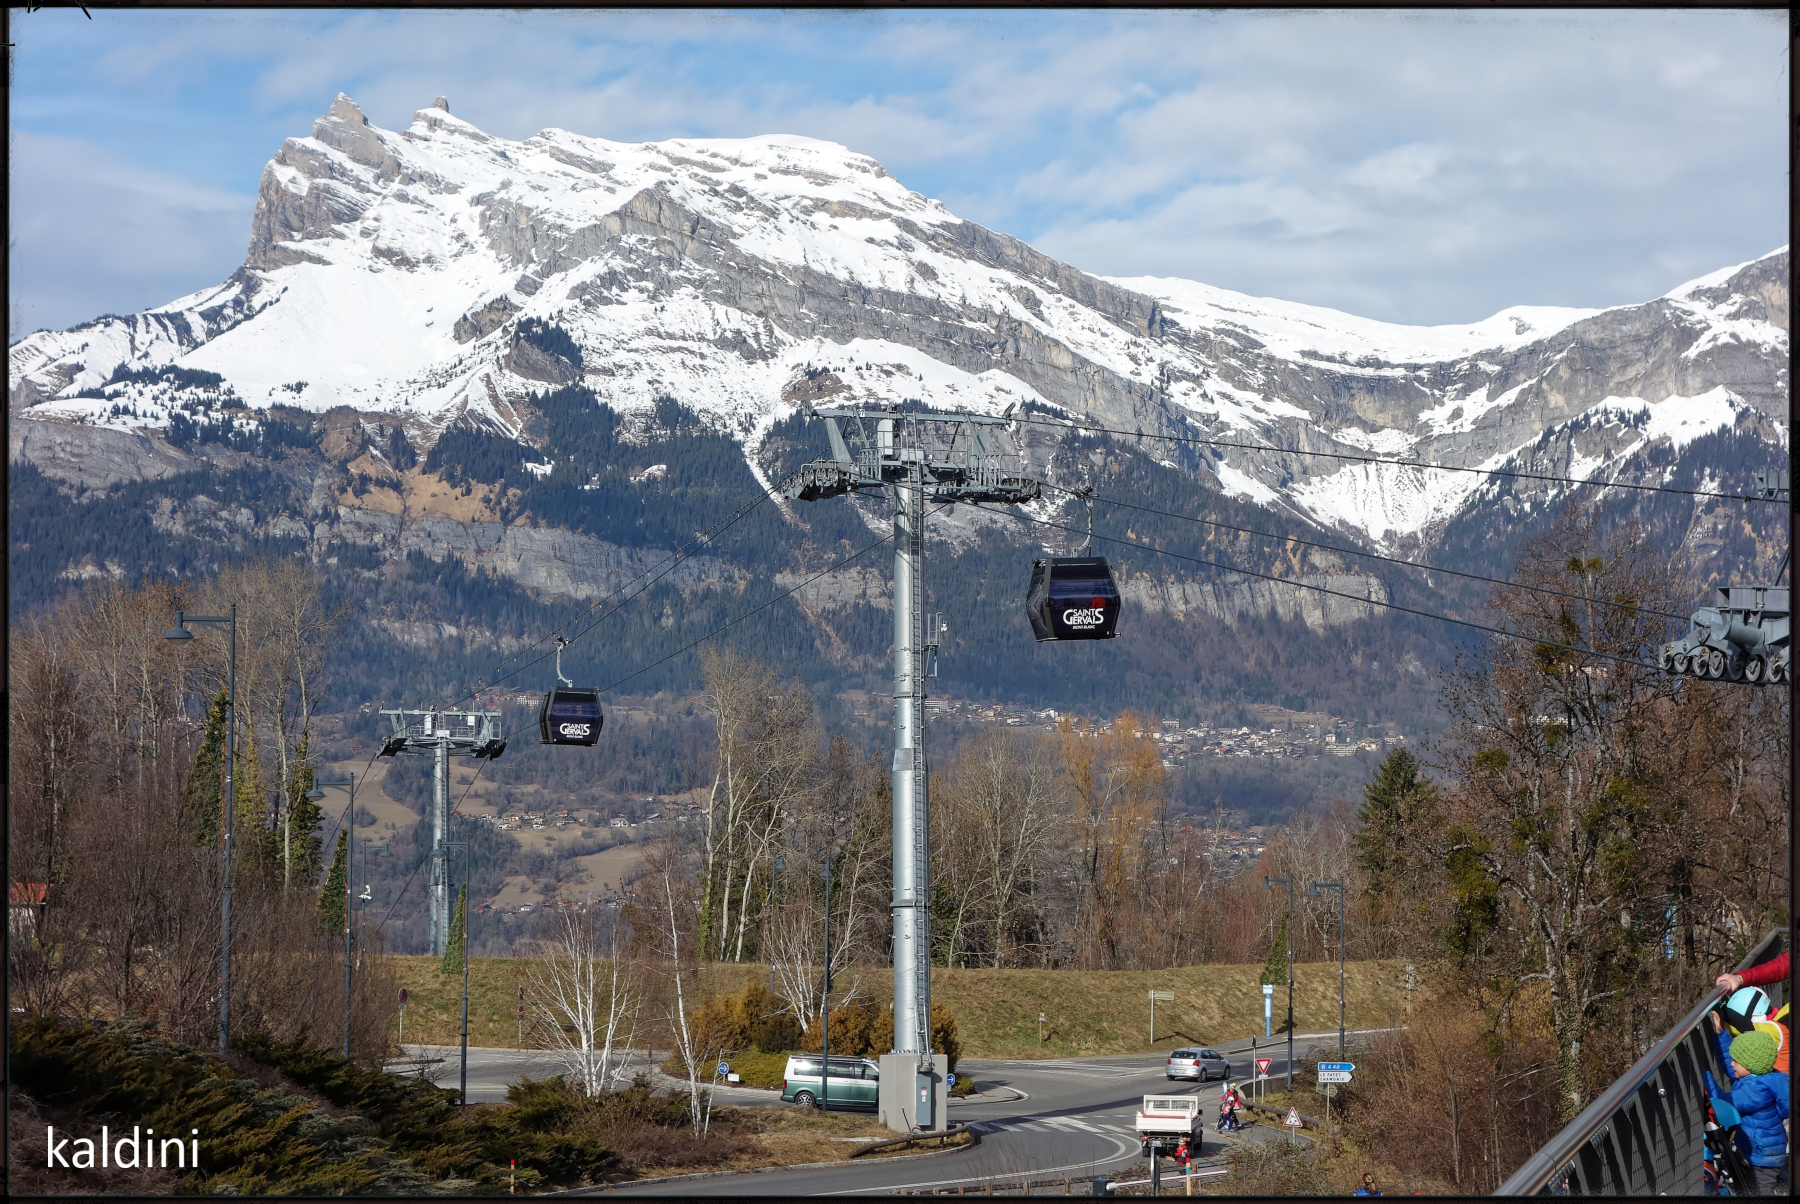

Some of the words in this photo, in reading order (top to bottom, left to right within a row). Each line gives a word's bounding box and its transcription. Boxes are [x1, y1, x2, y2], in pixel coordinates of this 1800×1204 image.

[1063, 608, 1104, 625] GERVAIS
[1072, 608, 1096, 617] SAINT
[560, 723, 590, 735] GERVAIS
